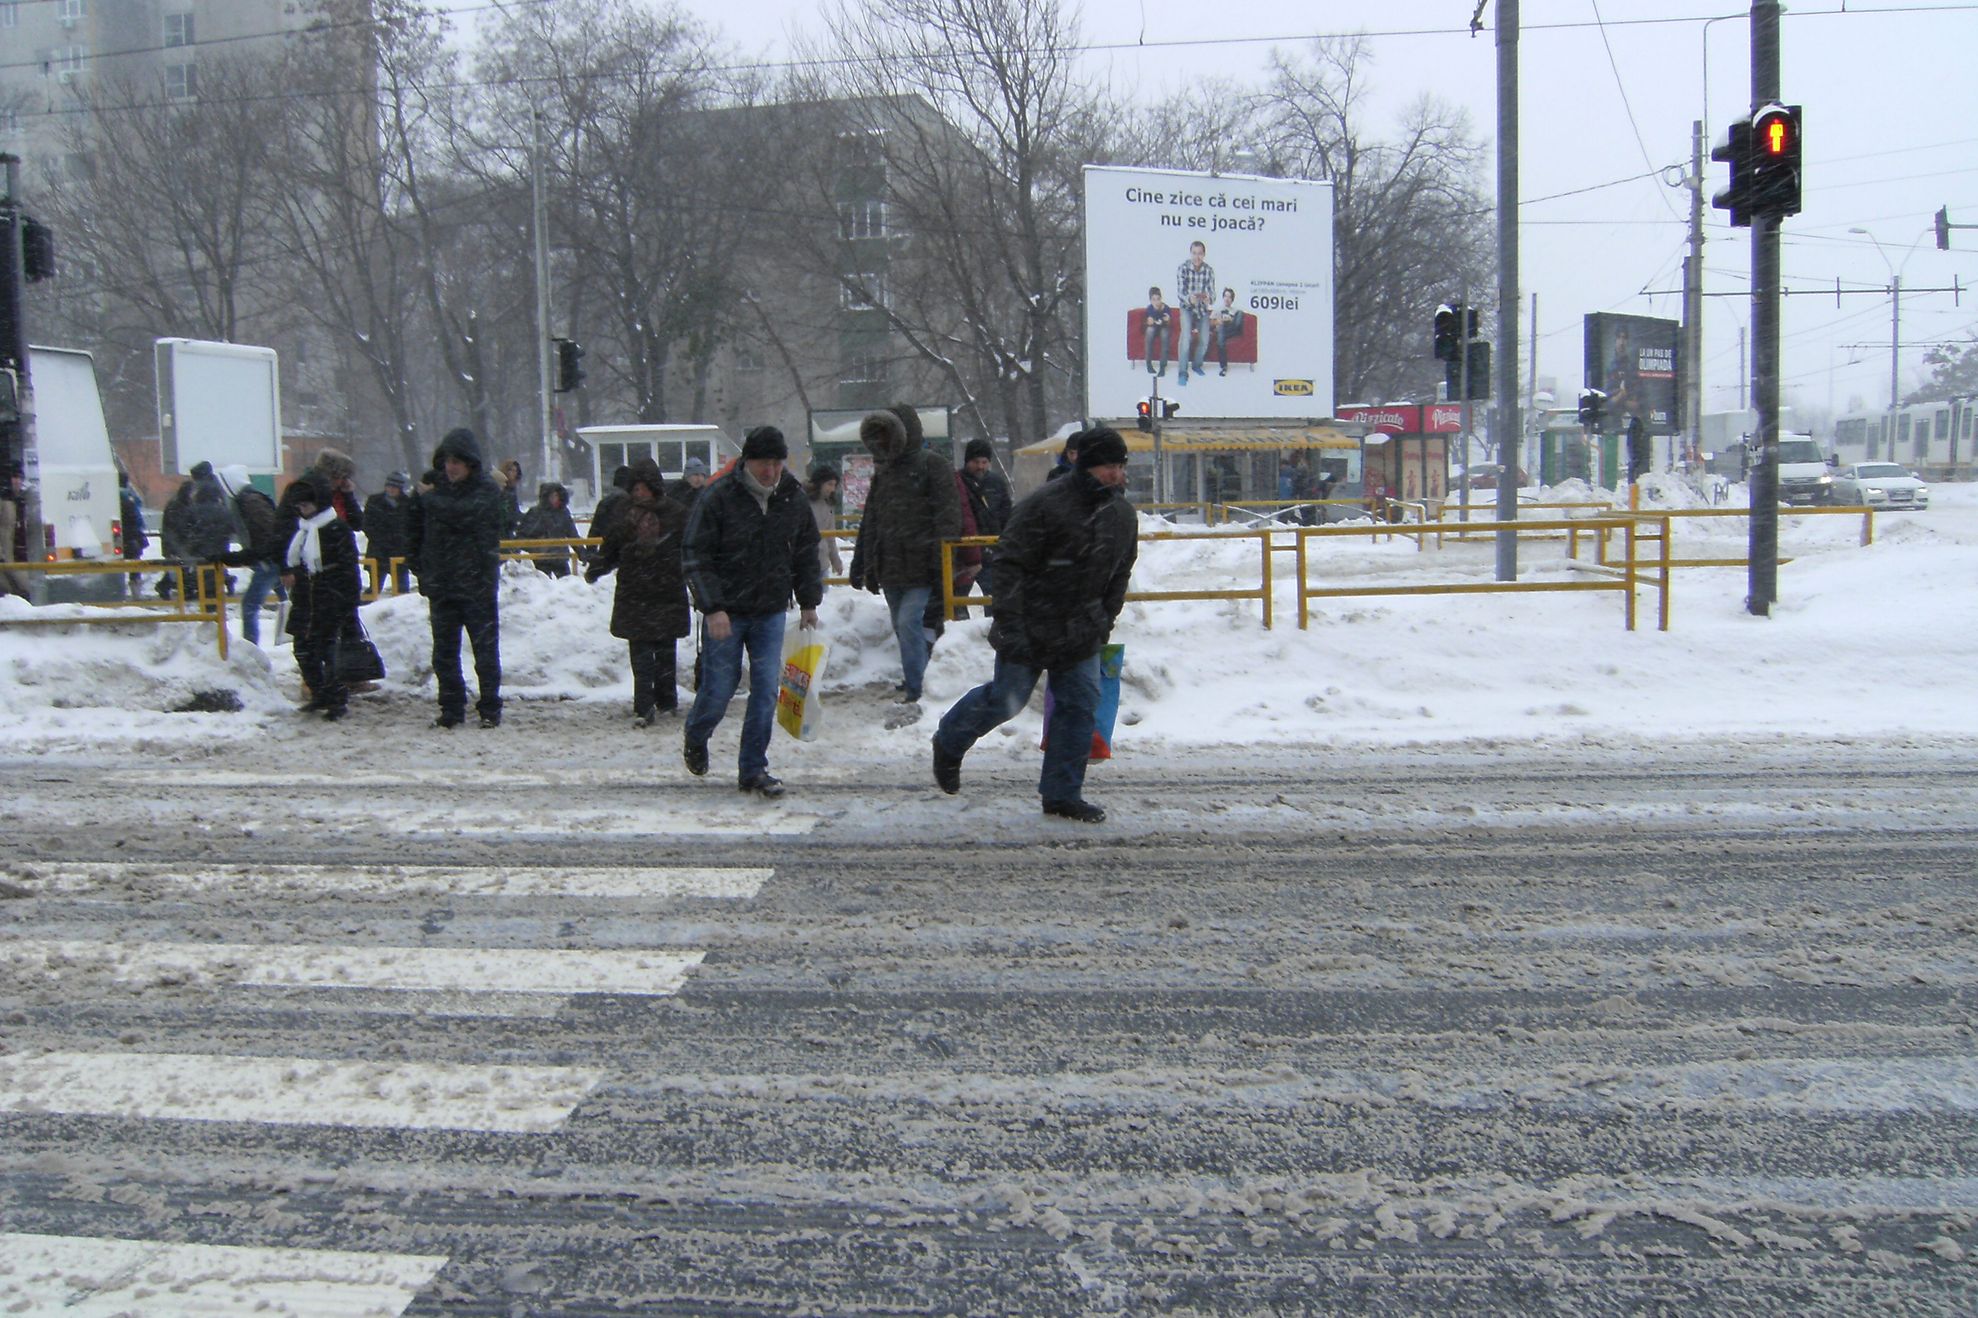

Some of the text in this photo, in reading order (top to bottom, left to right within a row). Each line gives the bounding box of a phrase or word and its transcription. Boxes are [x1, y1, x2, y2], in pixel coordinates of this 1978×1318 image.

[1126, 188, 1297, 212] Cine zice că cei mari
[1161, 214, 1265, 232] nu se joacă?
[1250, 296, 1298, 310] 609lei
